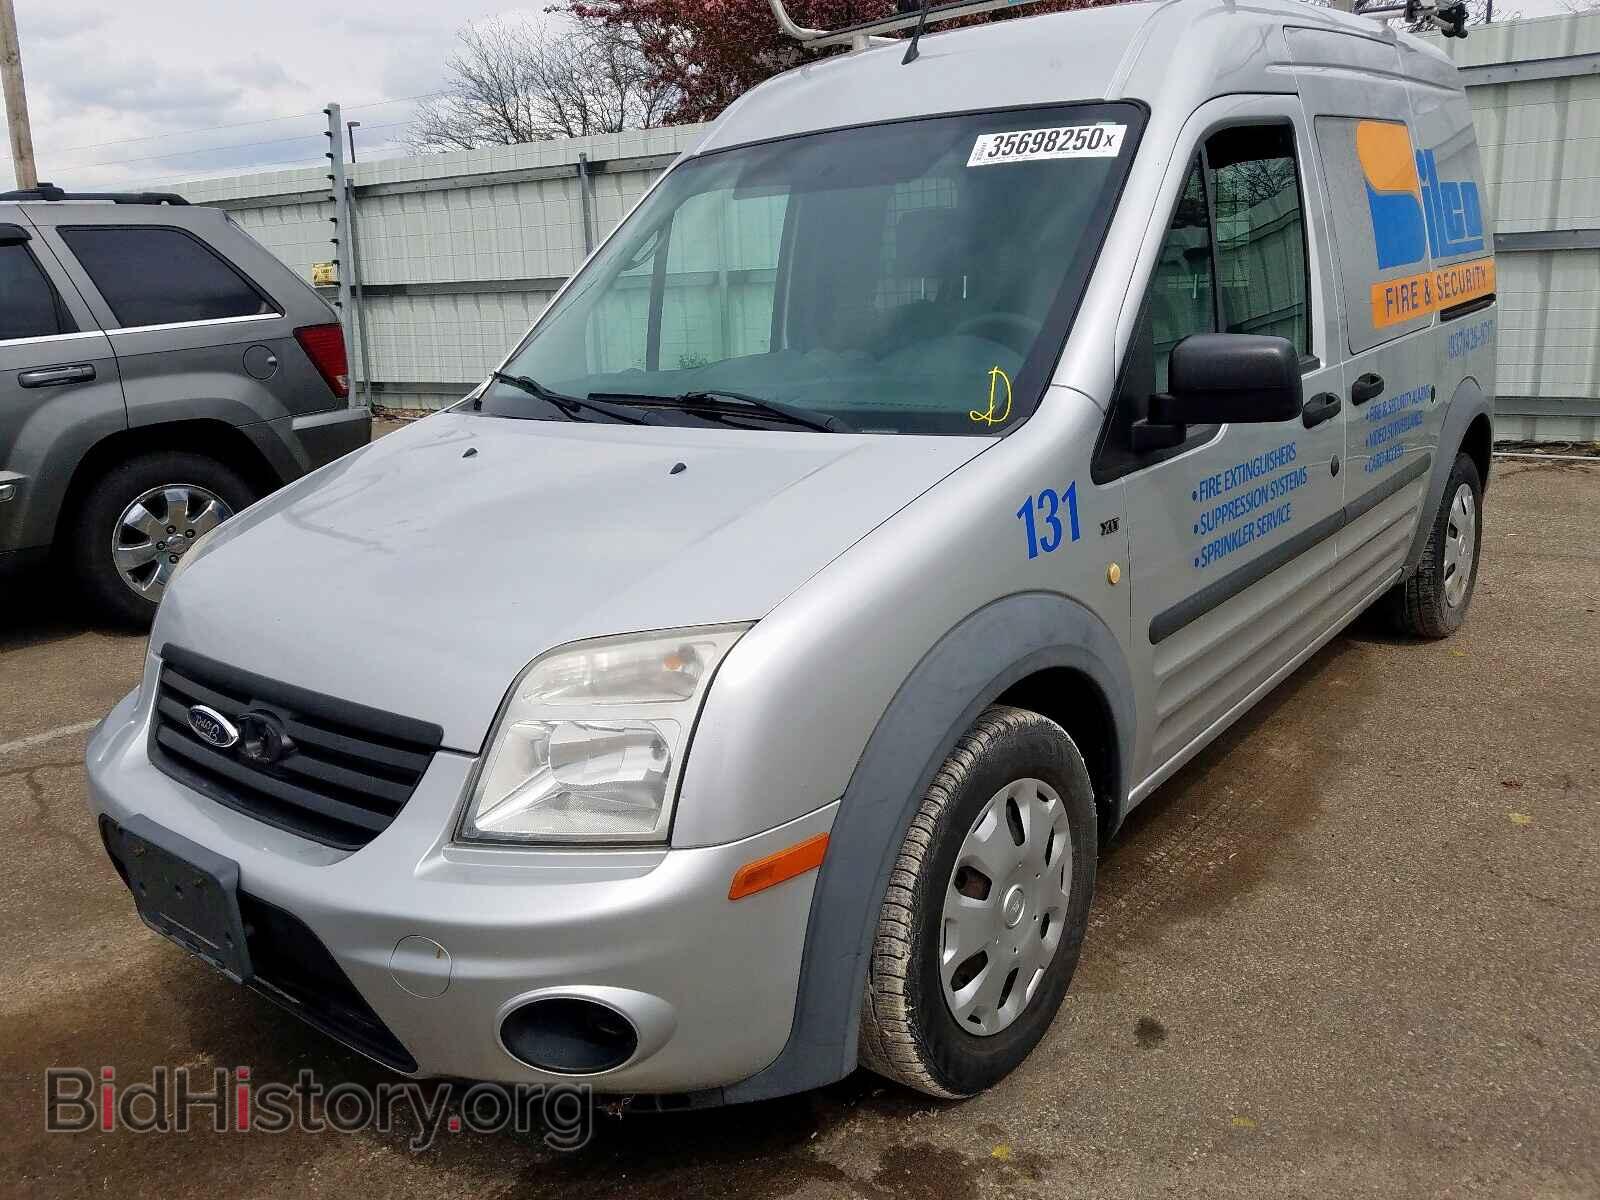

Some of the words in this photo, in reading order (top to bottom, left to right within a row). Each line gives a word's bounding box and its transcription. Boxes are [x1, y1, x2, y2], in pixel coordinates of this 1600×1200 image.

[1385, 280, 1419, 318] FIRE
[1423, 277, 1432, 305] &
[1436, 265, 1487, 301] SECURITY
[1199, 476, 1223, 502] FIRE
[1224, 442, 1297, 492] EXTINGUISHERS
[1200, 489, 1269, 535] SUPPRESSION
[1269, 466, 1308, 503] SYSTEMS
[1016, 480, 1081, 560] 131
[1200, 519, 1255, 568] SPRINKLER
[1255, 503, 1293, 540] SERVICE
